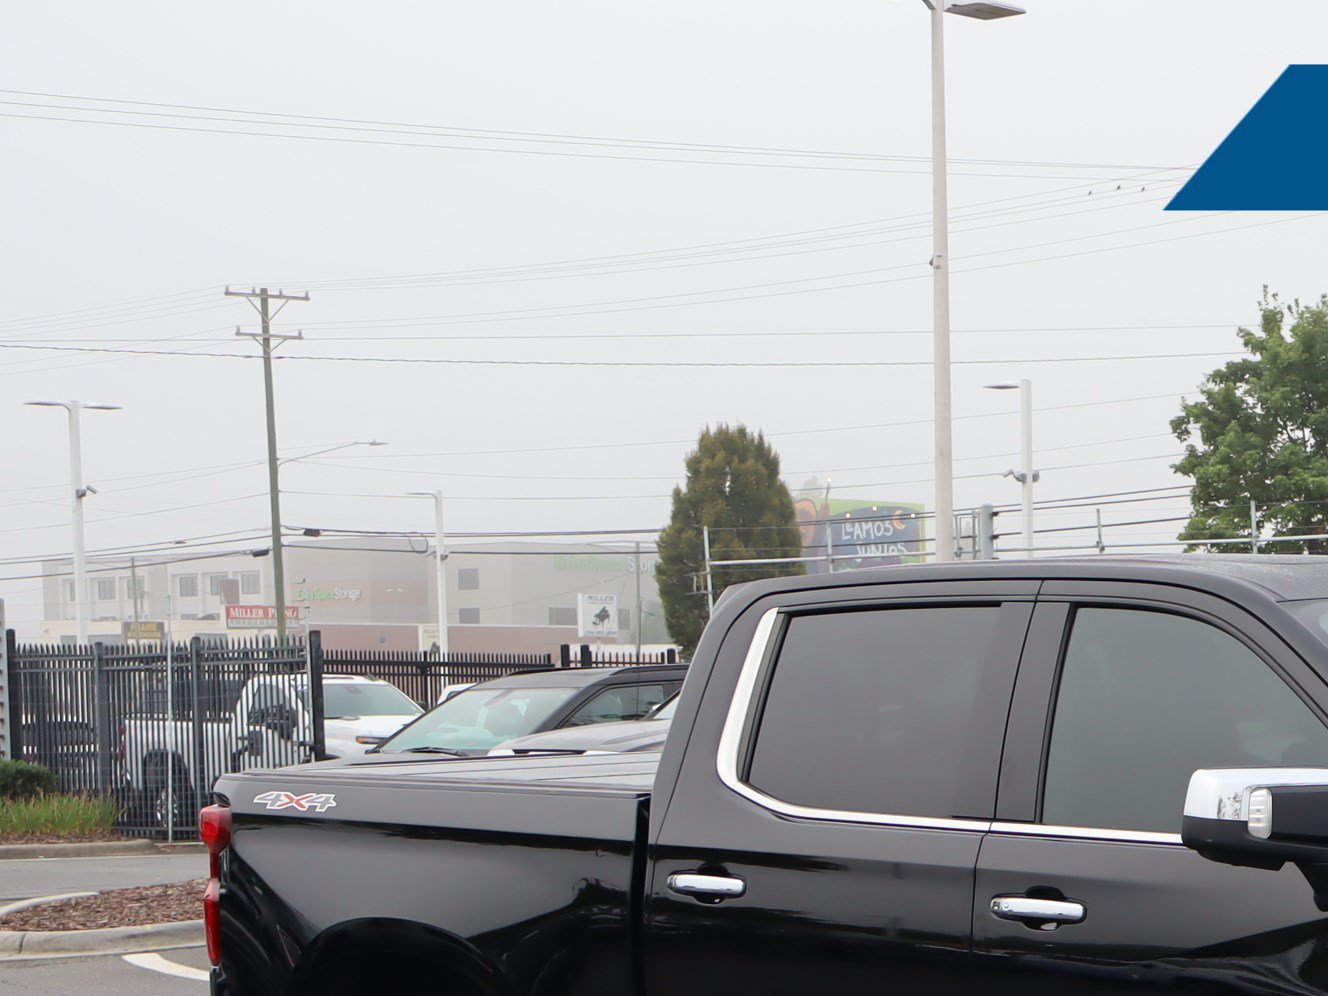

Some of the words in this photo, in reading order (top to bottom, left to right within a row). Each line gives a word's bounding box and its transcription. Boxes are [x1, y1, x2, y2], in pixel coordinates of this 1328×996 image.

[841, 520, 894, 541] LEAMOS
[229, 606, 264, 618] MILLER
[268, 606, 297, 618] PINO
